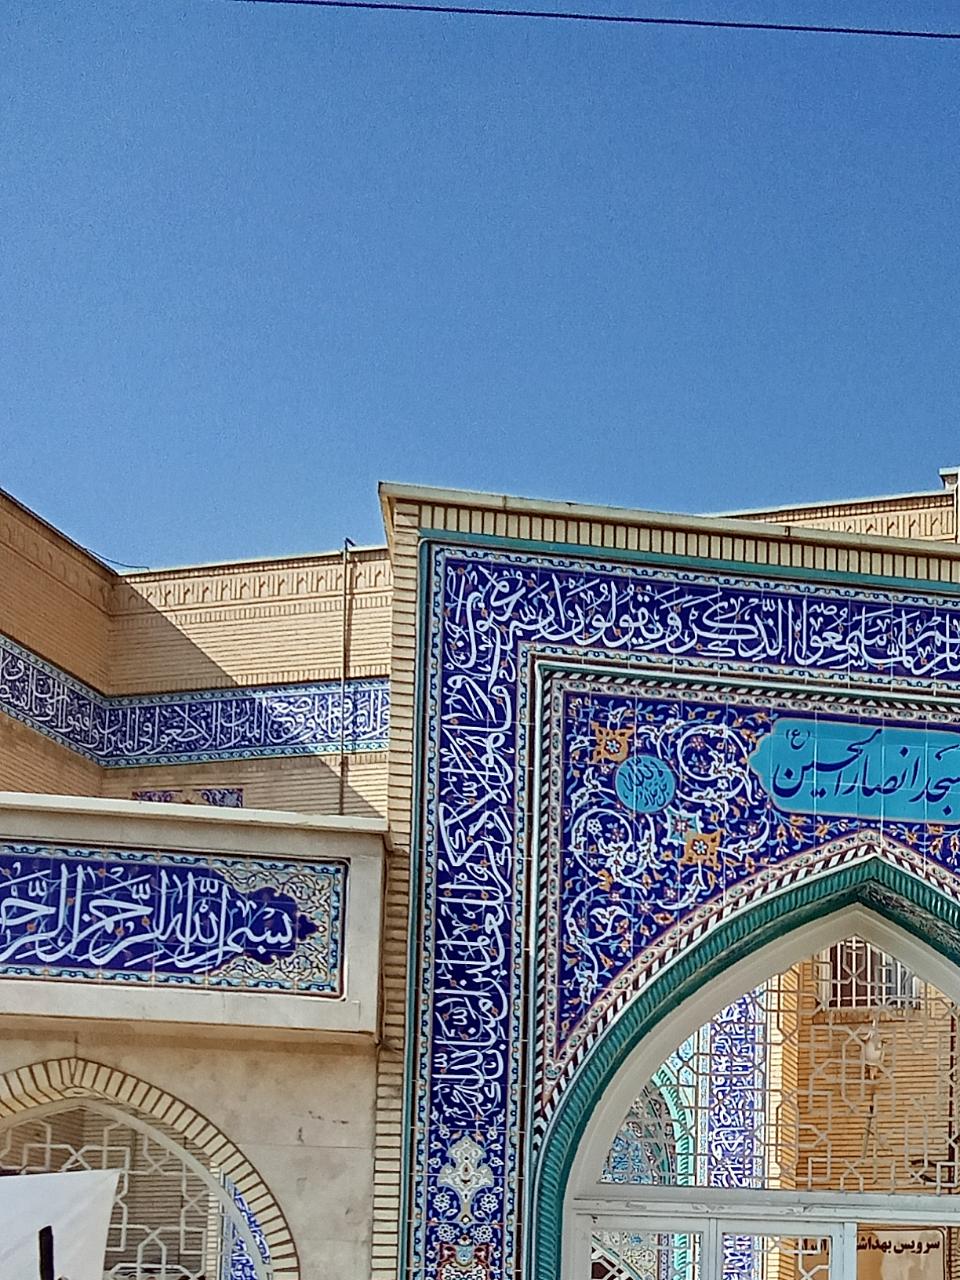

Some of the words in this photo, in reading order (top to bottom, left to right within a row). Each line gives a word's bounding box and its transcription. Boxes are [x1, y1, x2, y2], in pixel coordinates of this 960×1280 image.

[843, 746, 920, 797] انصار
[857, 1235, 893, 1254] بهداش
[893, 1238, 941, 1254] سرویس
